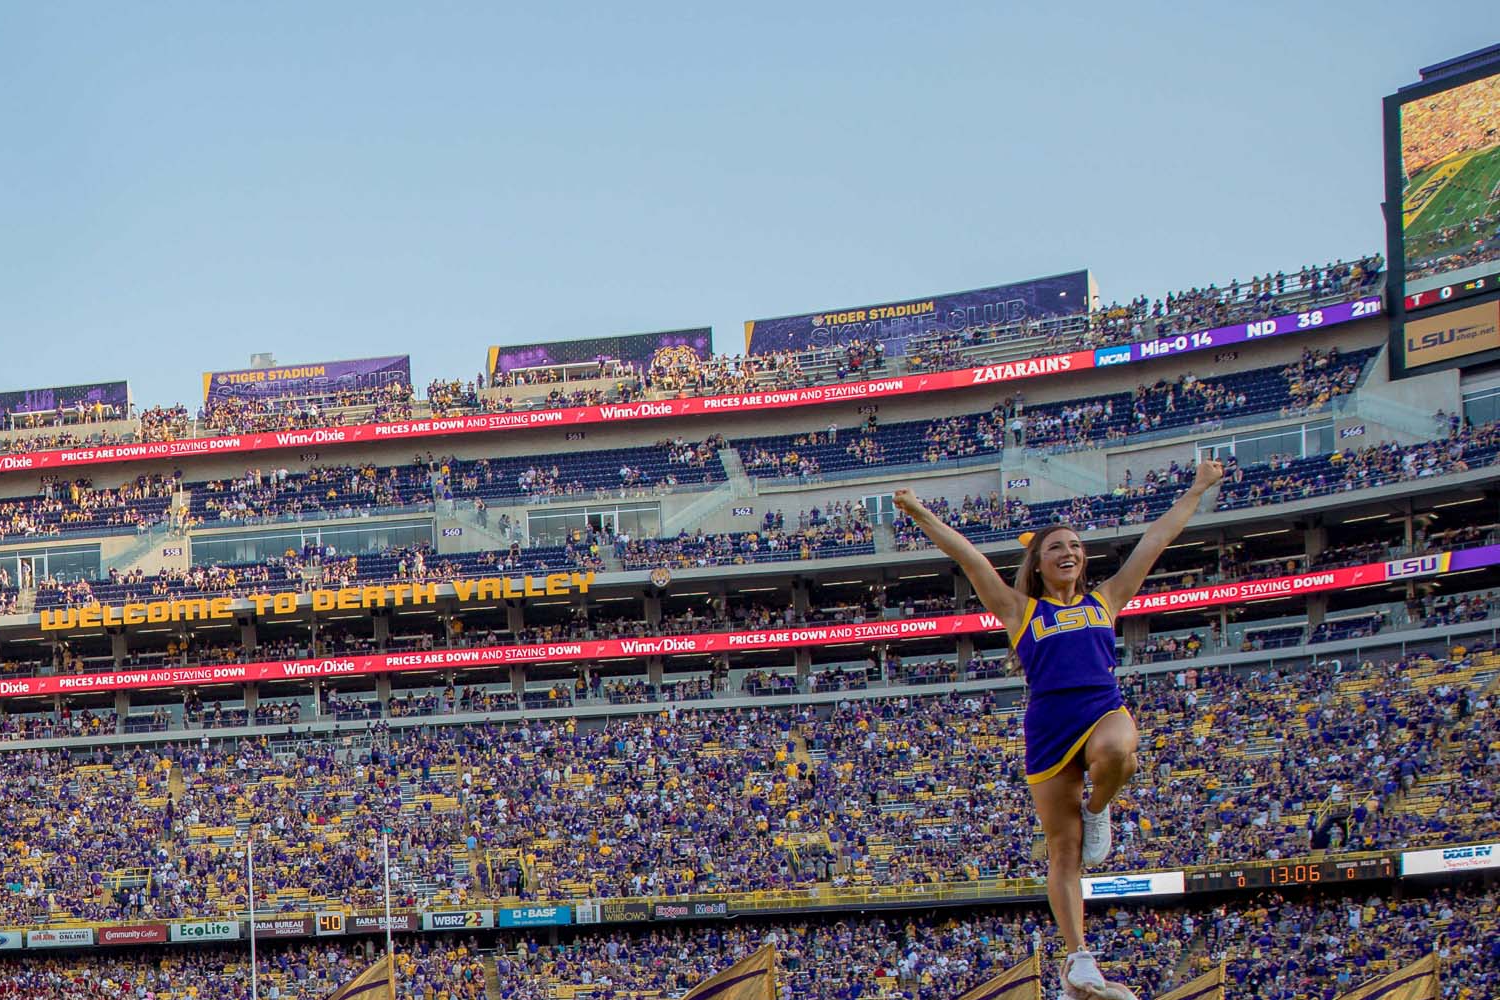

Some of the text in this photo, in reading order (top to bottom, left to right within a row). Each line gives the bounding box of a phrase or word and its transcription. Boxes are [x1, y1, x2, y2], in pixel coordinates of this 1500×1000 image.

[1440, 287, 1453, 299] 0
[824, 301, 934, 326] TIGER STADIUM
[945, 299, 1027, 332] CLUB
[1247, 311, 1323, 338] ND 38
[1191, 331, 1212, 347] 14
[228, 366, 325, 383] TIGER STADIUM
[972, 355, 1071, 383] ZATARAIN'S
[704, 380, 902, 409] PRICES ARE DOWN AND STAYING DOWN
[376, 412, 562, 435] PRICES ARE DOWN AND STAYING DOWN
[61, 438, 240, 462] PRICES ARE DOWN AND STAYING DOWN
[1010, 479, 1028, 488] 564
[445, 528, 460, 536] 560
[165, 548, 180, 556] 558
[1387, 557, 1436, 578] LSU
[1144, 596, 1167, 608] ARE
[1170, 592, 1209, 605] DOWN
[1212, 587, 1237, 599] AND
[1241, 580, 1290, 596] STAYING
[1293, 574, 1334, 588] DOWN
[40, 571, 595, 631] WELCOME TO DEATH VALLEY
[1030, 604, 1113, 642] LSU
[729, 621, 936, 645] PRICES ARE DOWN AND STAYING DOWN
[386, 645, 580, 666] PRICES ARE DOWN AND STAYING DOWN
[59, 667, 245, 688] PRICES ARE DOWN AND STAYING DOWN
[1270, 865, 1320, 884] 13:06
[1347, 868, 1354, 878] 0
[1238, 877, 1245, 887] 0
[528, 909, 557, 917] BASF
[605, 904, 625, 913] RELIEF
[605, 912, 646, 921] WINDOWS
[656, 903, 726, 918] Exxon Mobil
[320, 915, 341, 930] 40
[356, 917, 376, 926] FARM
[434, 913, 477, 927] WBRZ 2
[105, 929, 159, 940] Community Coffee
[180, 924, 230, 936] EcoLite
